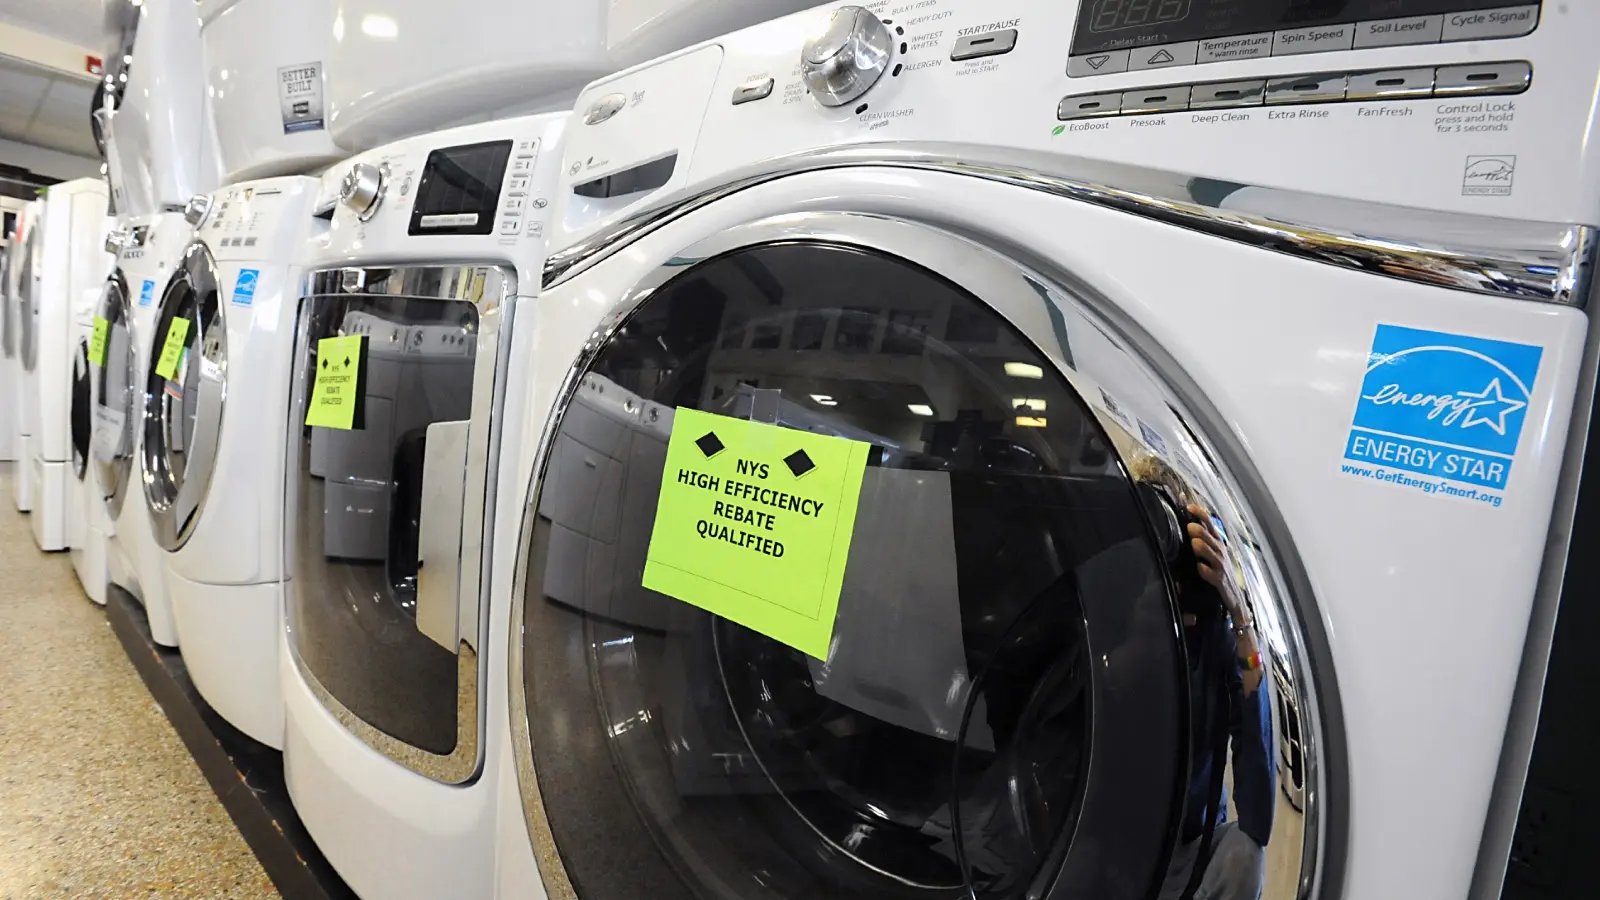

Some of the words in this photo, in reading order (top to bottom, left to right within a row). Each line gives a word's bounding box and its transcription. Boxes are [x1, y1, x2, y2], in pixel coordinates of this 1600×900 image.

[892, 4, 914, 15] BULKY
[915, 0, 937, 9] ITEMS
[907, 16, 931, 26] HEAVY
[931, 10, 954, 20] DUTY
[1451, 13, 1486, 27] Cycle
[1488, 10, 1530, 25] Signal
[957, 18, 1020, 36] START/PAUSE
[1370, 22, 1392, 34] Soil
[1394, 20, 1426, 32] Level
[911, 31, 943, 42] WHITEST
[1111, 37, 1135, 45] Delay
[1203, 36, 1268, 50] Temperature
[1281, 34, 1305, 44] Spin
[1308, 29, 1344, 41] Speed
[910, 40, 938, 50] WHITES
[1215, 50, 1237, 58] warm
[1239, 48, 1259, 56] rinse
[904, 60, 942, 71] ALLERGEN
[282, 67, 316, 83] BETTER
[287, 80, 312, 94] BUILT
[1268, 110, 1296, 120] Extra
[1299, 109, 1329, 119] Rinse
[1357, 107, 1413, 117] FanFresh
[1437, 103, 1482, 114] Control
[1486, 101, 1515, 112] Lock
[860, 112, 882, 122] CLEAN
[883, 108, 914, 119] WASHER
[1130, 116, 1166, 127] Presoak
[1191, 114, 1218, 125] Deep
[1221, 112, 1250, 122] Clean
[1434, 116, 1462, 126] press
[1465, 114, 1485, 123] and
[1488, 113, 1514, 122] hold
[1069, 121, 1109, 132] EcoBoost
[1437, 124, 1452, 133] for
[1455, 124, 1460, 132] 3
[1463, 123, 1508, 133] seconds
[1362, 384, 1488, 426] energy
[1352, 436, 1441, 470] ENERGY
[1443, 454, 1504, 483] STAR
[736, 459, 770, 480] NYS
[1341, 463, 1503, 507] www.GetEnergySmart.org
[677, 469, 720, 492] HIGH
[724, 480, 824, 518] EFFICIENCY
[713, 500, 776, 531] REBATE
[696, 519, 785, 559] QUALIFIED
